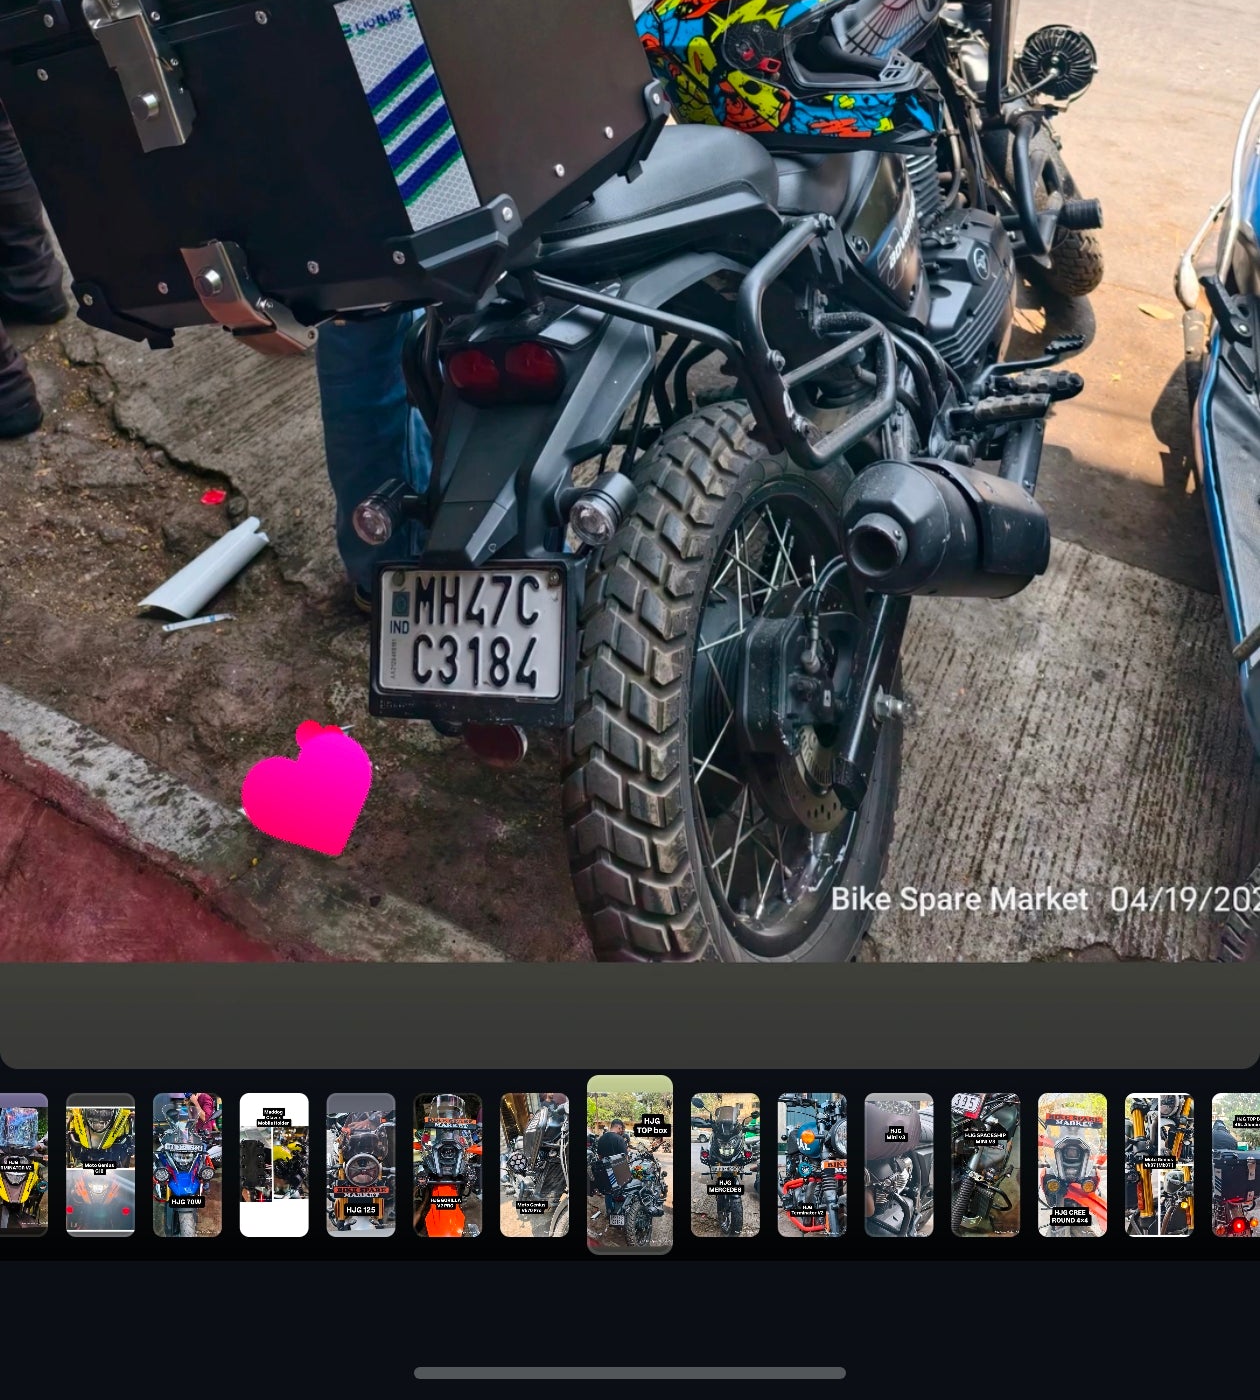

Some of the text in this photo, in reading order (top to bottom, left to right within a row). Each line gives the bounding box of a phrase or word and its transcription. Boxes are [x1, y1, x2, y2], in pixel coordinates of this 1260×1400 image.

[413, 574, 540, 627] MH47C
[390, 620, 410, 635] IND
[412, 633, 538, 690] C3184
